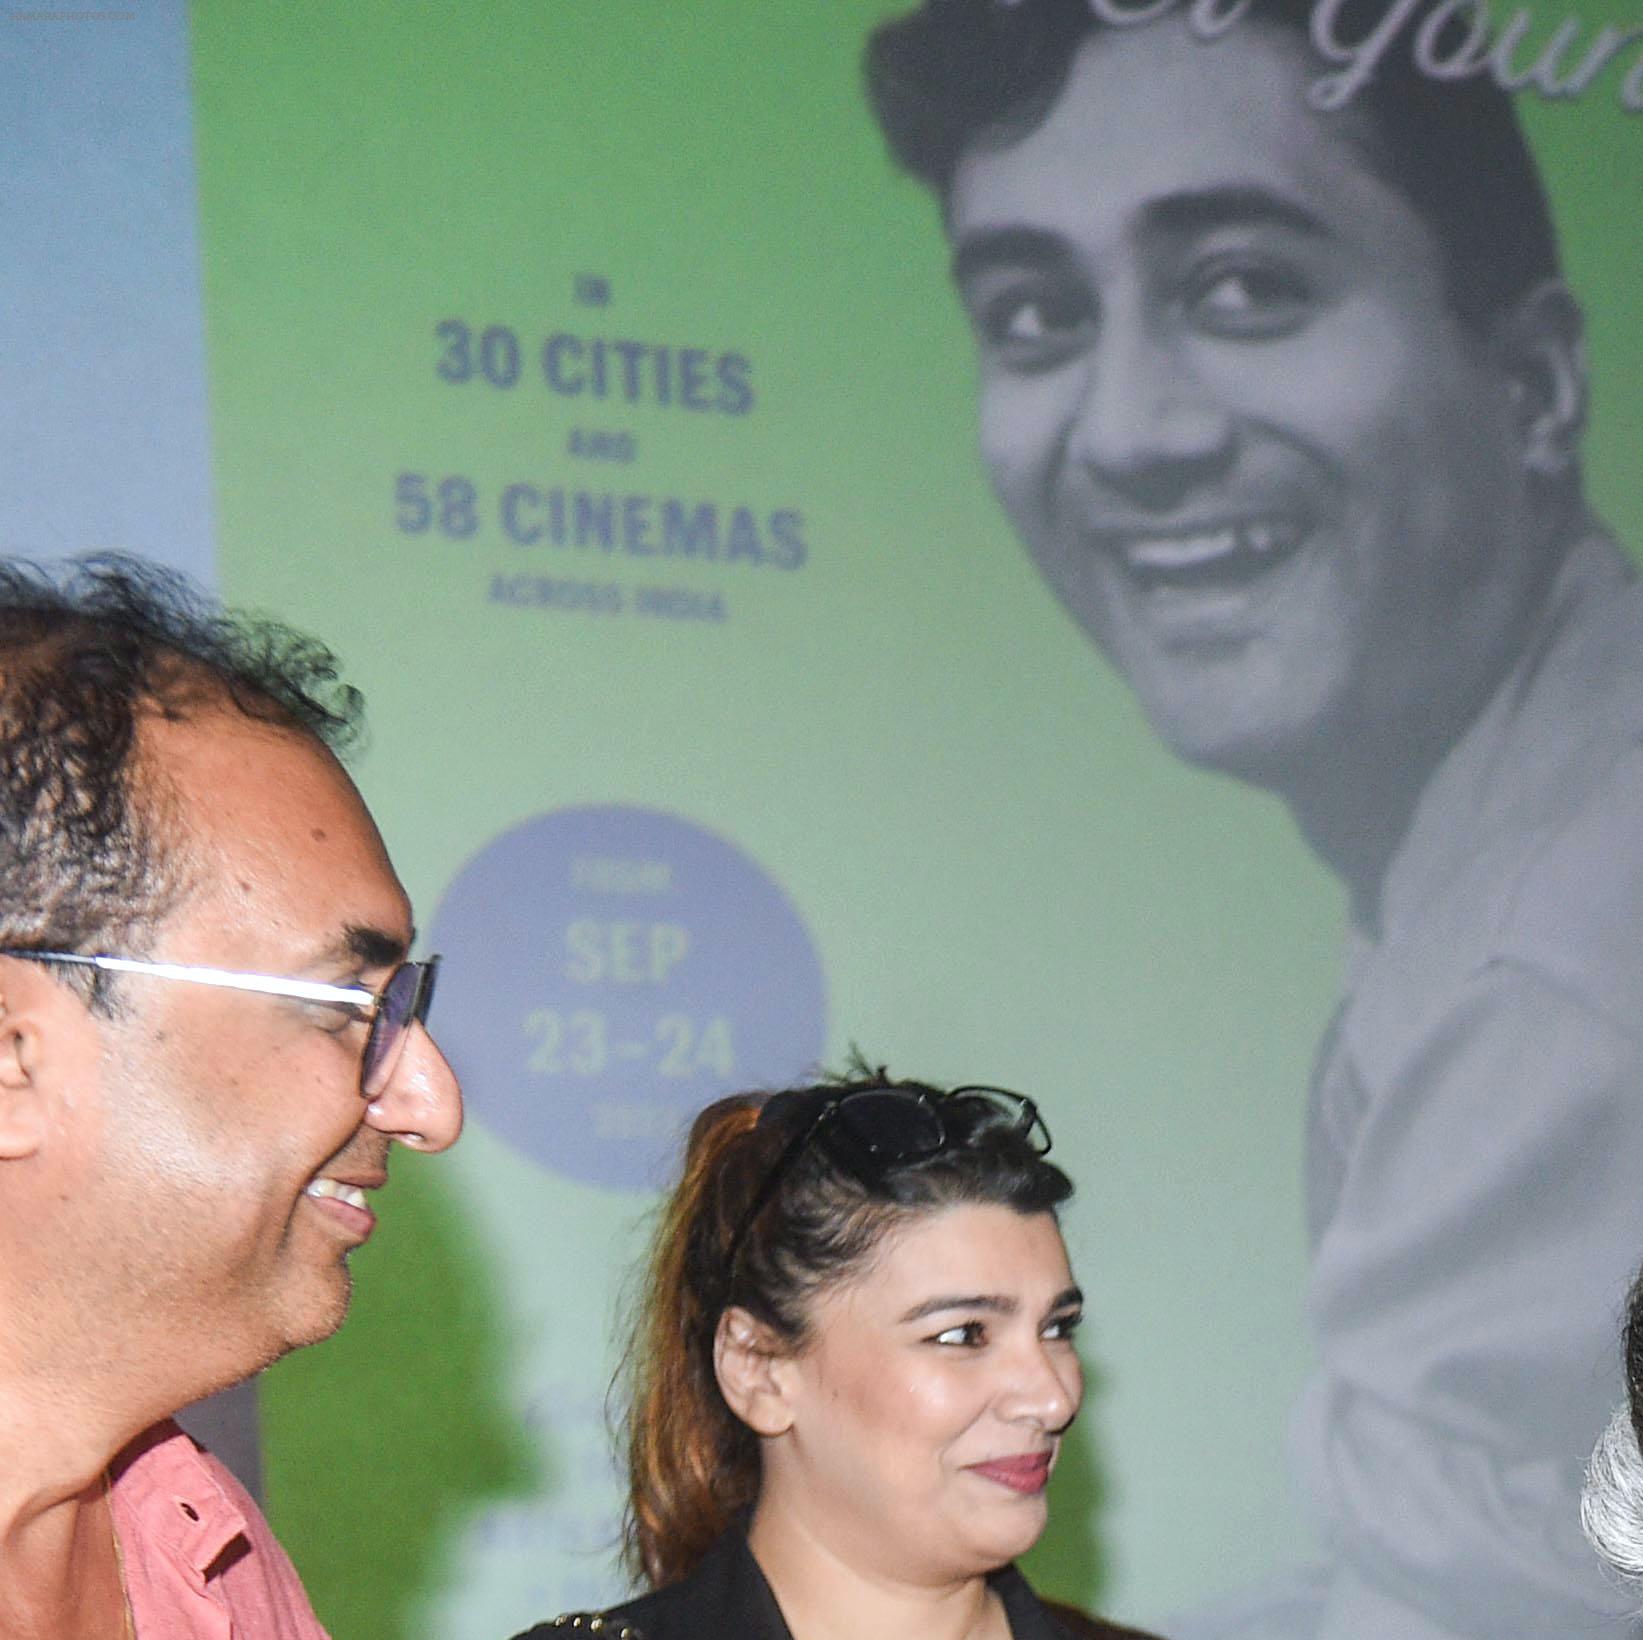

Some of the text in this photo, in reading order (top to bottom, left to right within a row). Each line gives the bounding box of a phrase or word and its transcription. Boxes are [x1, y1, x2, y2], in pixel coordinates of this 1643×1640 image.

[434, 317, 757, 419] 30 CITIES
[395, 470, 809, 572] 58 CINEMAS
[564, 917, 693, 988] SEP
[521, 1007, 737, 1080] 23-24
